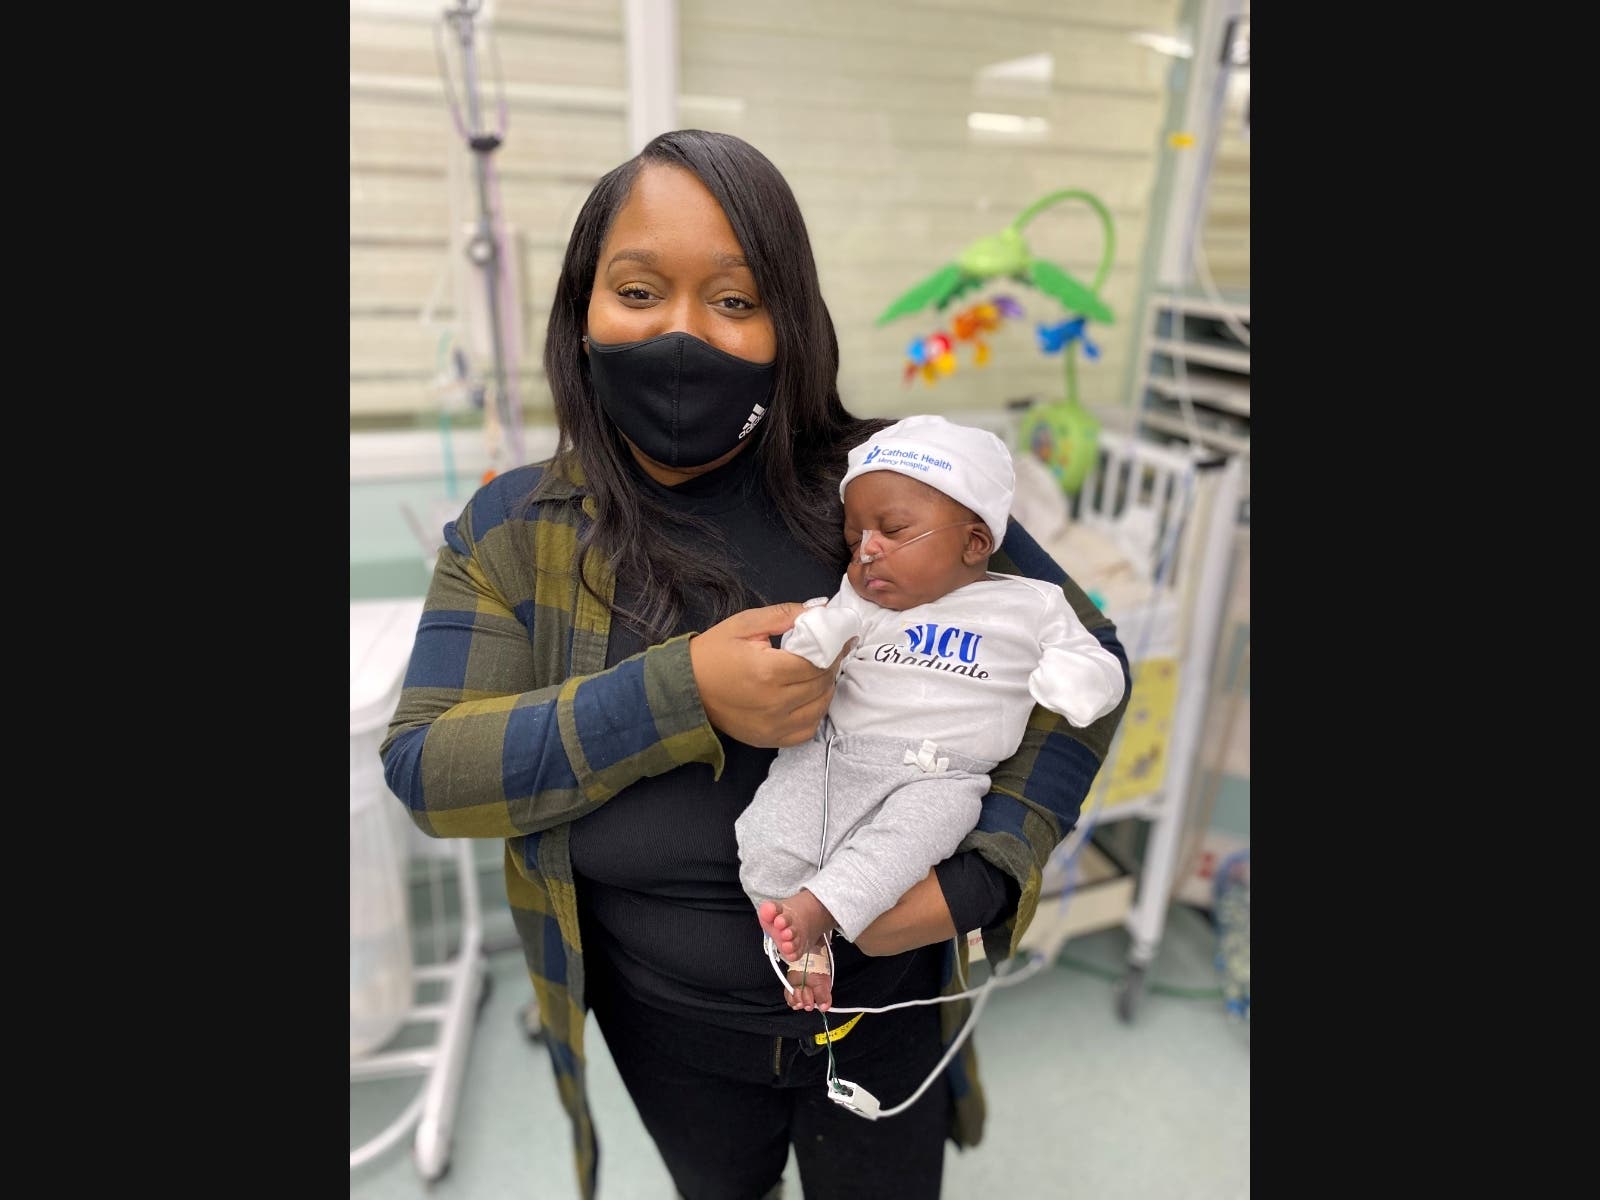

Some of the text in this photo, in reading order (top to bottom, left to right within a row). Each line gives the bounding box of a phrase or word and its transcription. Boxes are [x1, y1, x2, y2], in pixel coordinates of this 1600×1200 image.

[878, 457, 931, 472] Mercy Hospital
[881, 448, 953, 472] Catholic Health
[904, 623, 983, 664] NICU
[874, 643, 991, 681] Graduate
